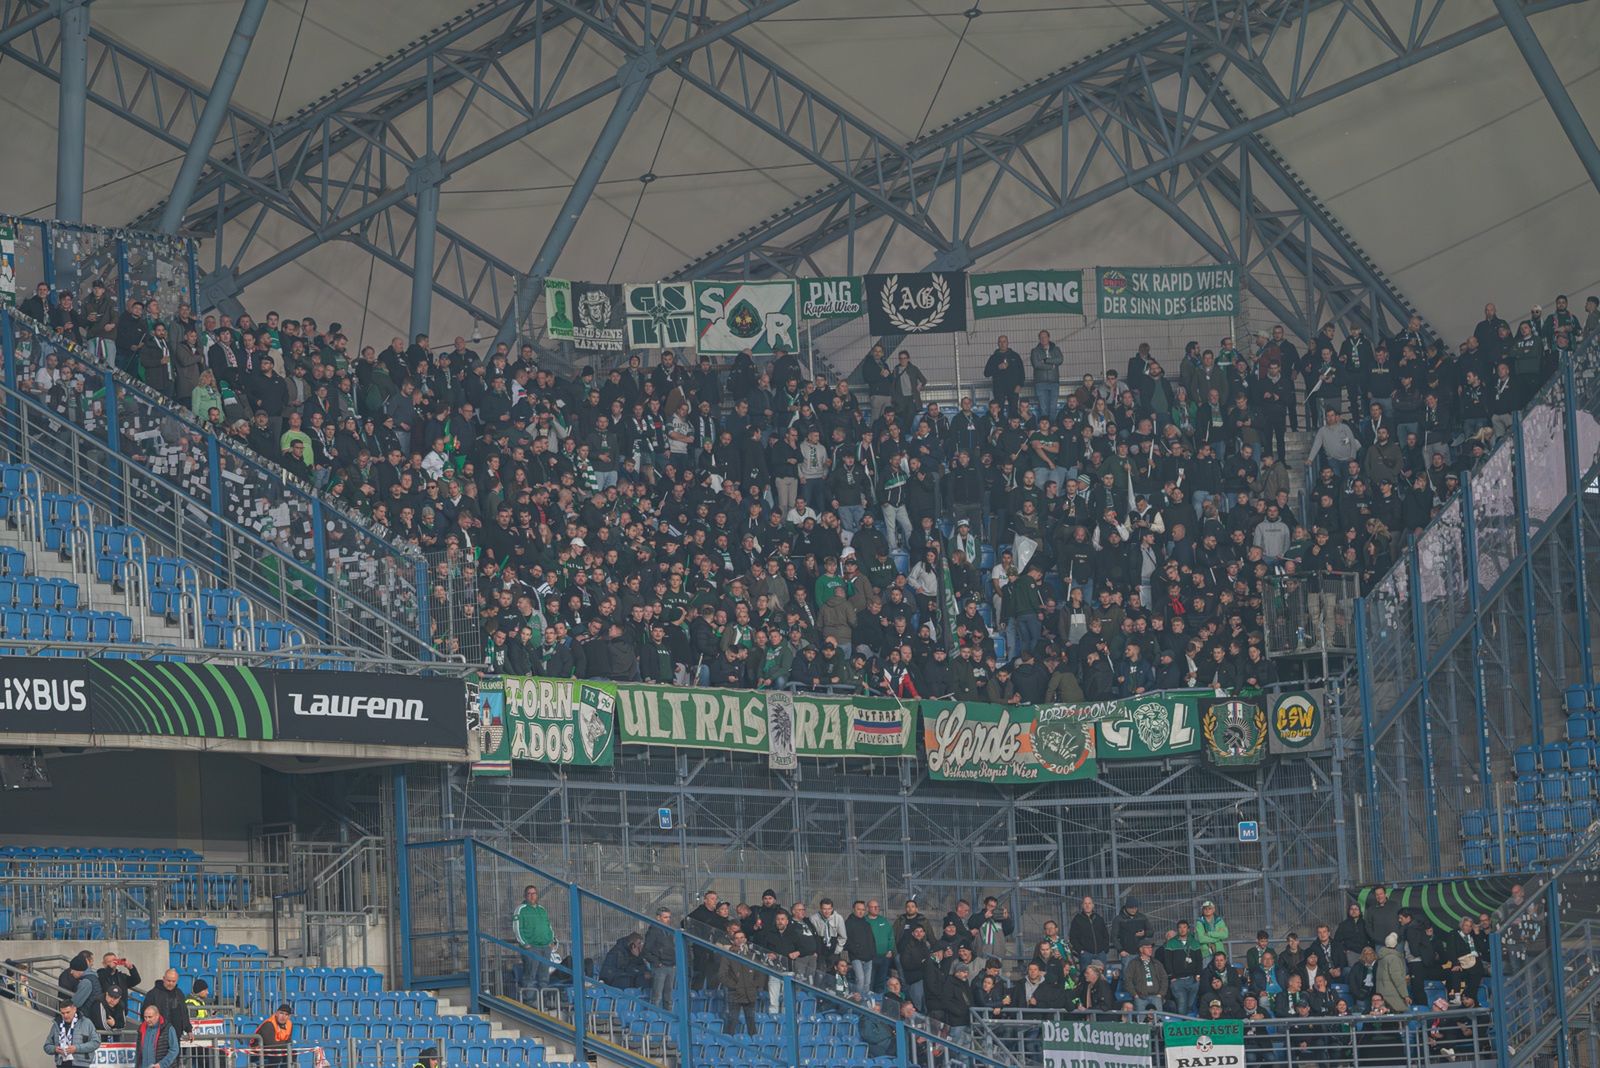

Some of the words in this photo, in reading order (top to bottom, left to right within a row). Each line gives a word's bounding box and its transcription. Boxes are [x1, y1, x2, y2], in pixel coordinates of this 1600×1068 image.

[810, 280, 851, 305] PNG
[1131, 273, 1149, 291] SK
[1153, 272, 1193, 292] RAPID
[1197, 270, 1234, 289] WIEN
[974, 281, 1078, 306] SPEISING
[1104, 297, 1127, 313] DER
[1130, 297, 1161, 314] SINN
[1165, 297, 1187, 315] DES
[1190, 294, 1234, 313] LEBENS
[804, 300, 833, 317] Rapid
[834, 302, 859, 313] Wien
[573, 327, 594, 338] RAPID
[0, 678, 87, 711] iXBUS
[506, 678, 574, 720] TORN
[618, 691, 767, 746] ULTRAS
[511, 720, 574, 763] ADOS
[929, 702, 1022, 771] Lords
[979, 761, 1008, 782] Rapid
[1010, 762, 1038, 778] Wien
[1050, 762, 1075, 774] 2004
[1242, 829, 1255, 837] M1
[1043, 1020, 1070, 1042] Die
[1072, 1022, 1149, 1051] Klempner
[1176, 1056, 1239, 1068] RAPID
